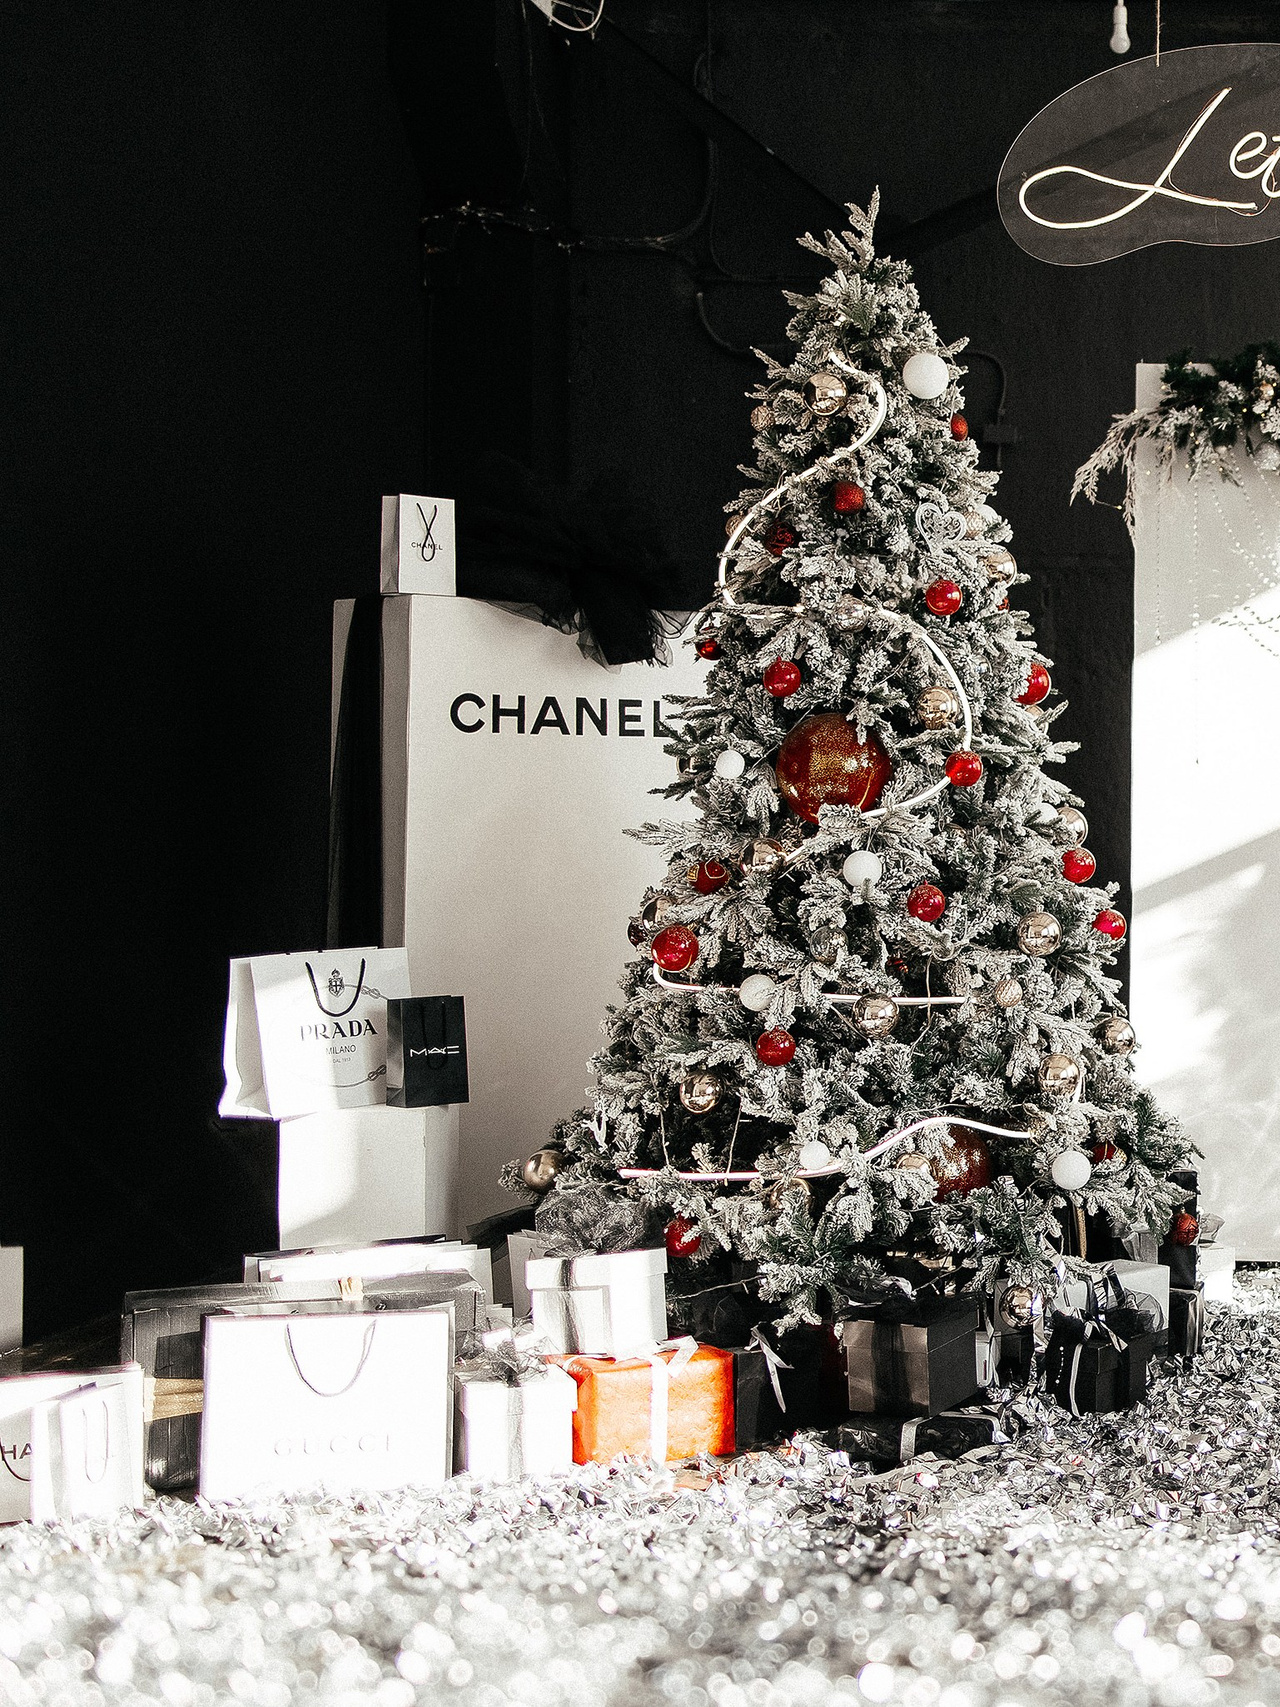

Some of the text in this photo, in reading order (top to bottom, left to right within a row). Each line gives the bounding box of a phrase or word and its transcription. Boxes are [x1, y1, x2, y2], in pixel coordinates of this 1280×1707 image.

[449, 692, 672, 738] CHANEL
[300, 1018, 379, 1042] PRADA
[326, 1044, 357, 1055] MILANO
